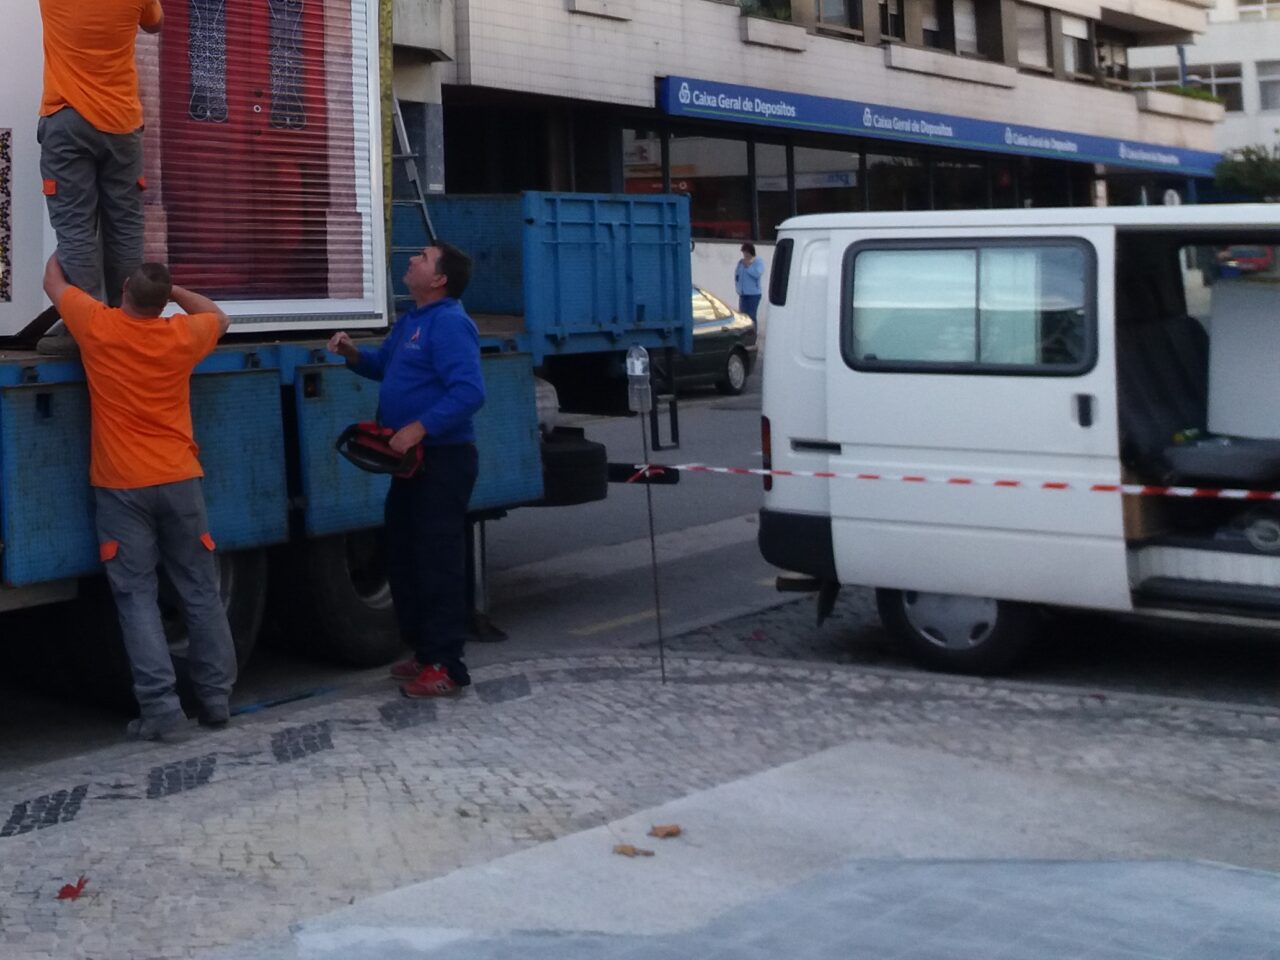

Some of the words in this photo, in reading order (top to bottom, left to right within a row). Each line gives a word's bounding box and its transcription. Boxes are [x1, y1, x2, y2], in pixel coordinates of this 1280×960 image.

[692, 90, 717, 108] Caixa
[718, 93, 741, 111] Geral
[742, 97, 753, 112] de
[754, 98, 796, 118] Depositos
[873, 114, 892, 129] Caixa
